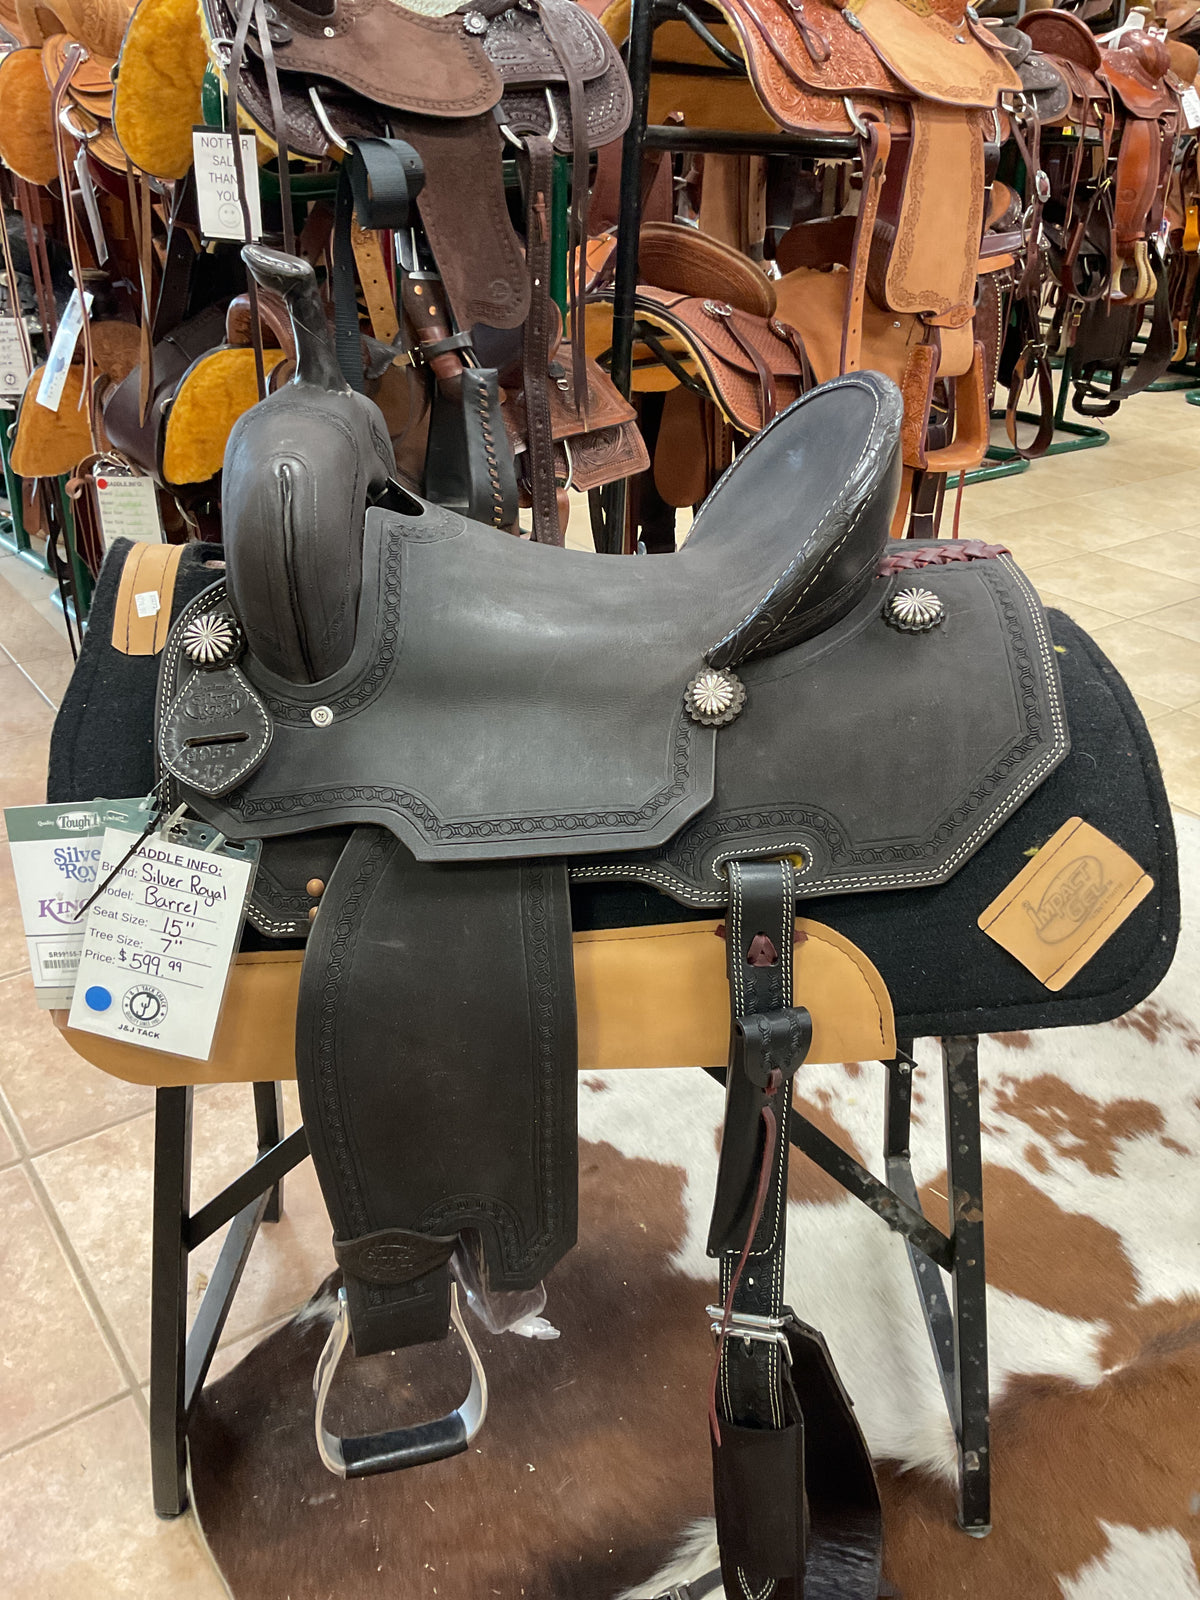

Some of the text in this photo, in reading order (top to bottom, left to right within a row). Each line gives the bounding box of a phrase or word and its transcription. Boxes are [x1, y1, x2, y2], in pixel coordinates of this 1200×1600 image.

[201, 137, 249, 150] NOT FR
[213, 155, 233, 167] SAL
[209, 172, 238, 184] THAN
[216, 190, 240, 202] YOU
[54, 846, 101, 866] Silve
[59, 863, 97, 883] Roy
[187, 858, 222, 876] INFO:
[101, 861, 227, 907] Brnd: Silver Royal
[145, 885, 197, 915] Barrel
[93, 906, 195, 938] Seat Size: 15"
[89, 928, 183, 953] Tree Size: 7"
[85, 949, 116, 964] Price:
[118, 1024, 161, 1039] J&J TACK
